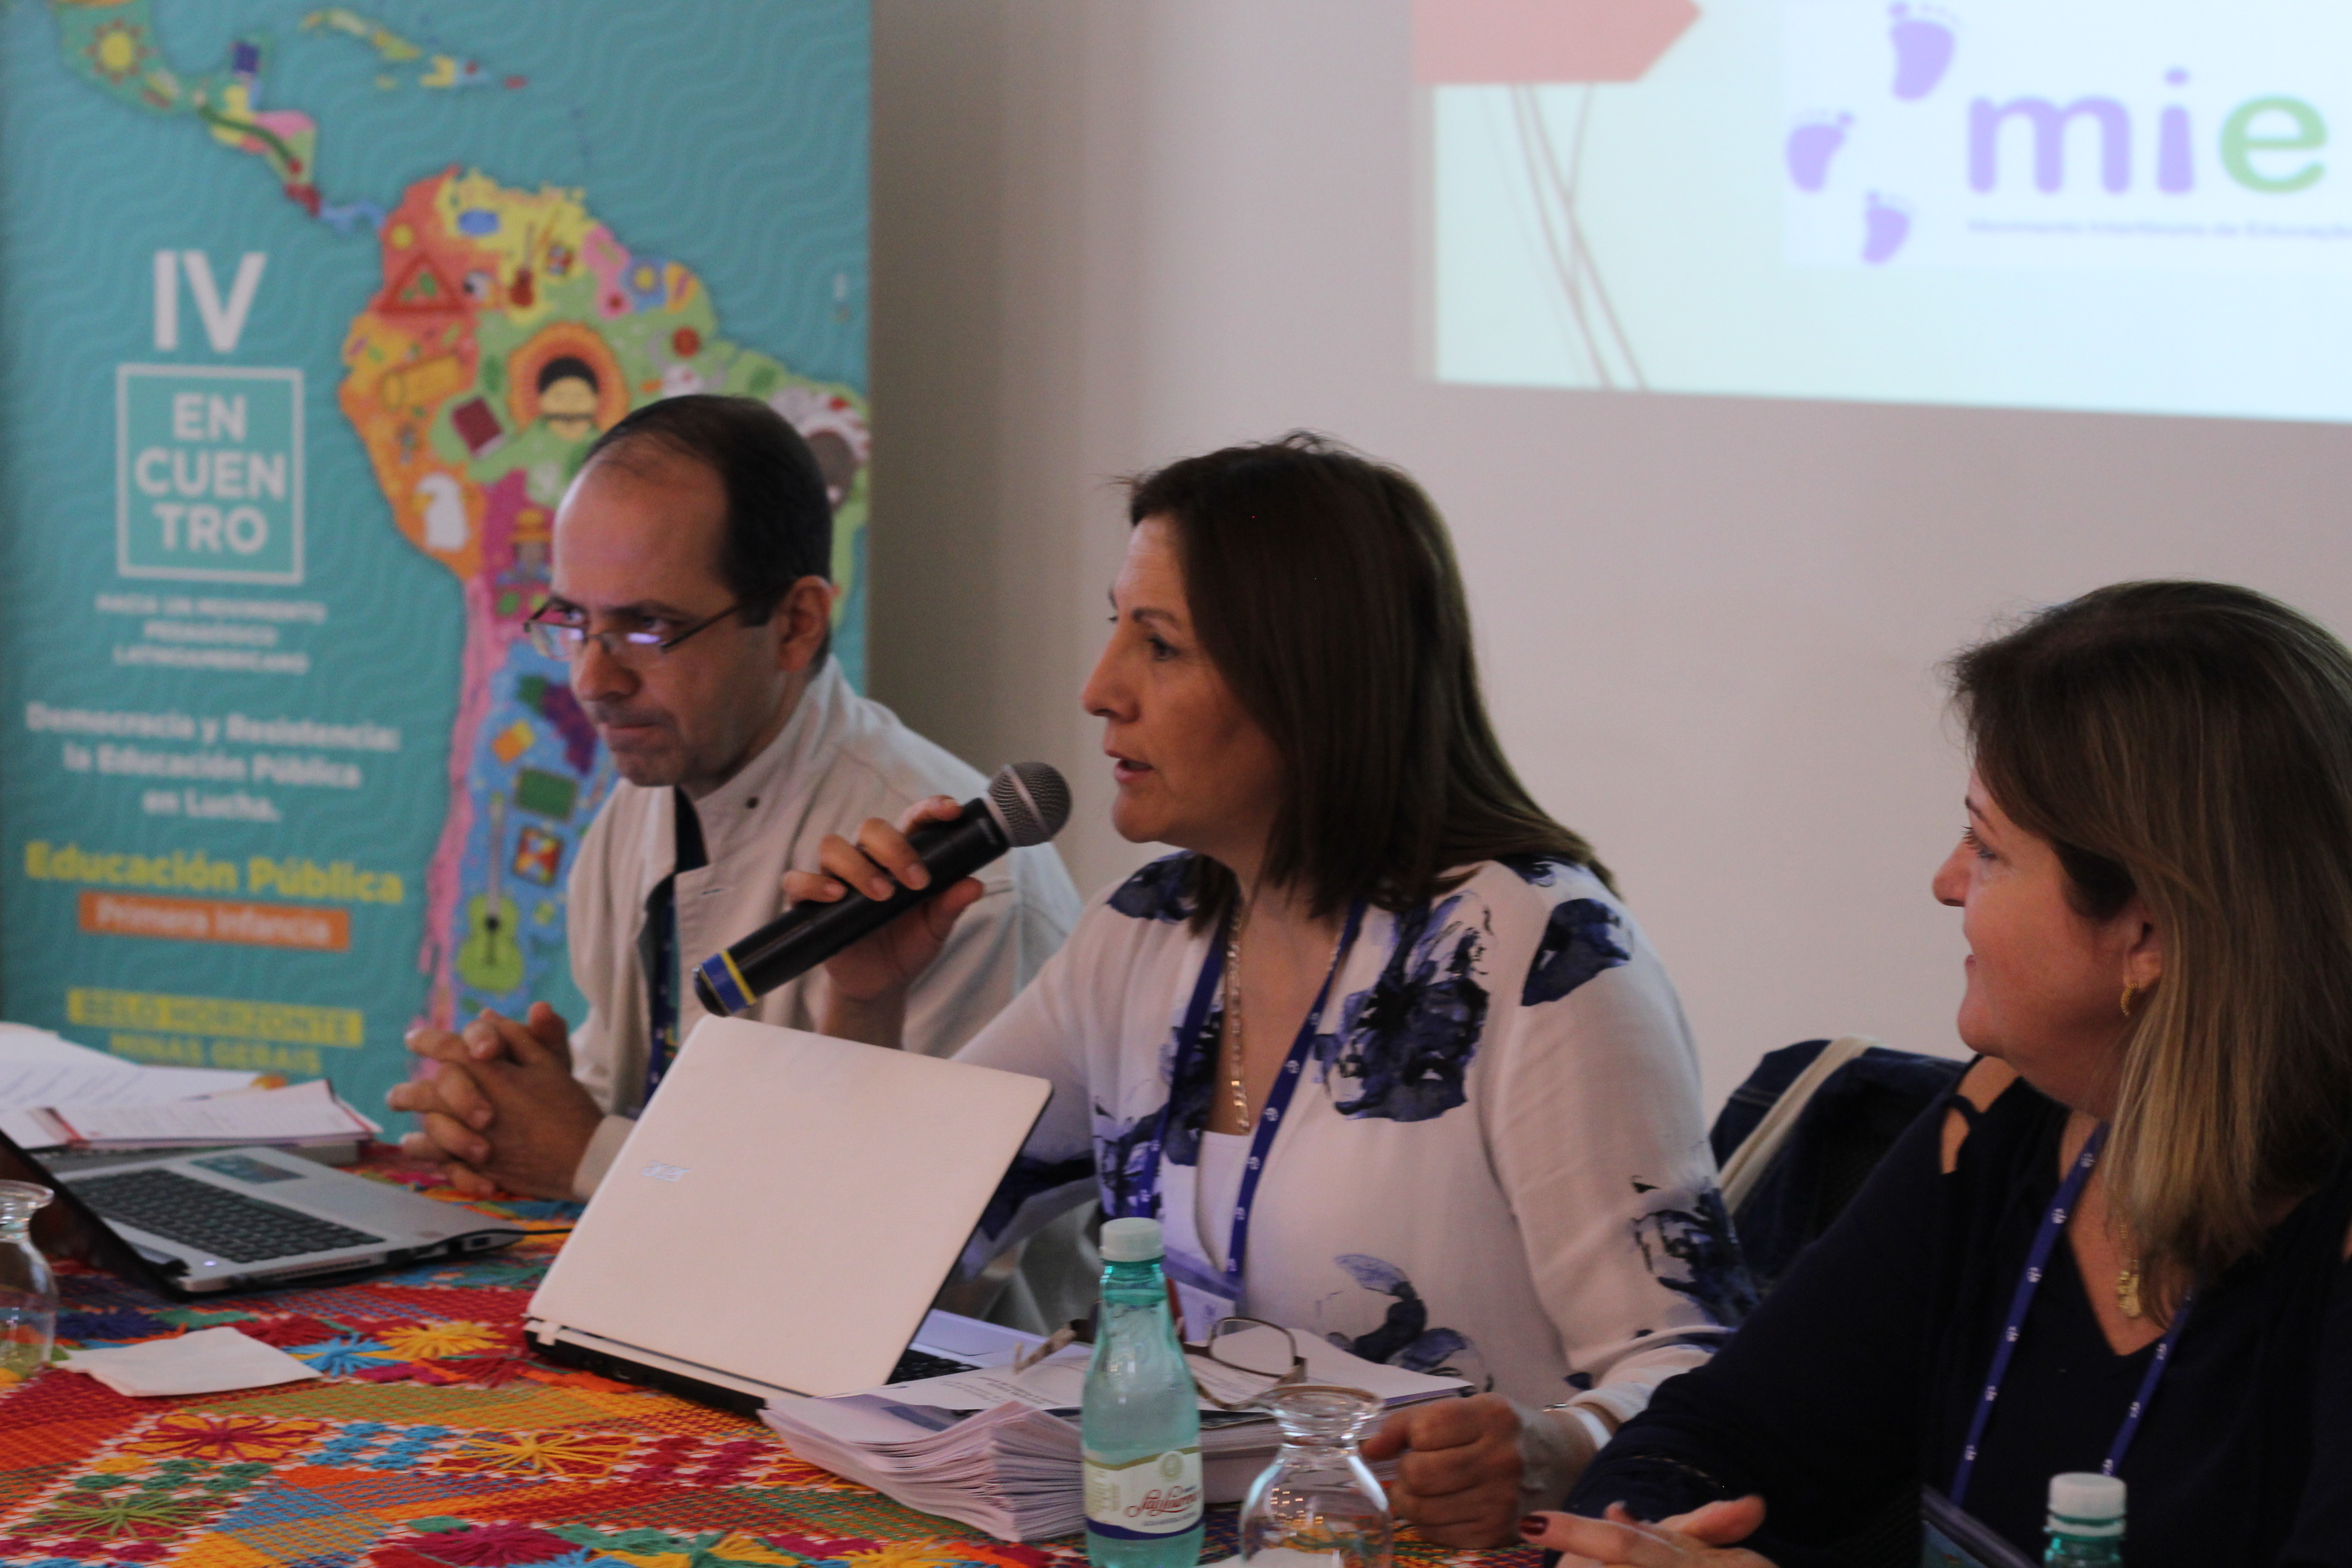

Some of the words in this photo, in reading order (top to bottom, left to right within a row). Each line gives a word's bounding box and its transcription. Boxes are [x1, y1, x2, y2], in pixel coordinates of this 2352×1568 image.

[1966, 66, 2328, 196] mie
[154, 250, 266, 352] IV
[173, 392, 246, 441] EN
[134, 447, 286, 500] CUEN
[153, 502, 267, 554] TRO
[26, 701, 195, 740] Democracia
[201, 719, 219, 744] y
[64, 741, 91, 772] la
[97, 744, 246, 780] Educación
[252, 755, 361, 789] Pública
[142, 791, 180, 814] en
[25, 841, 237, 891] Educación
[247, 856, 404, 903] Pública
[96, 896, 210, 932] Primera
